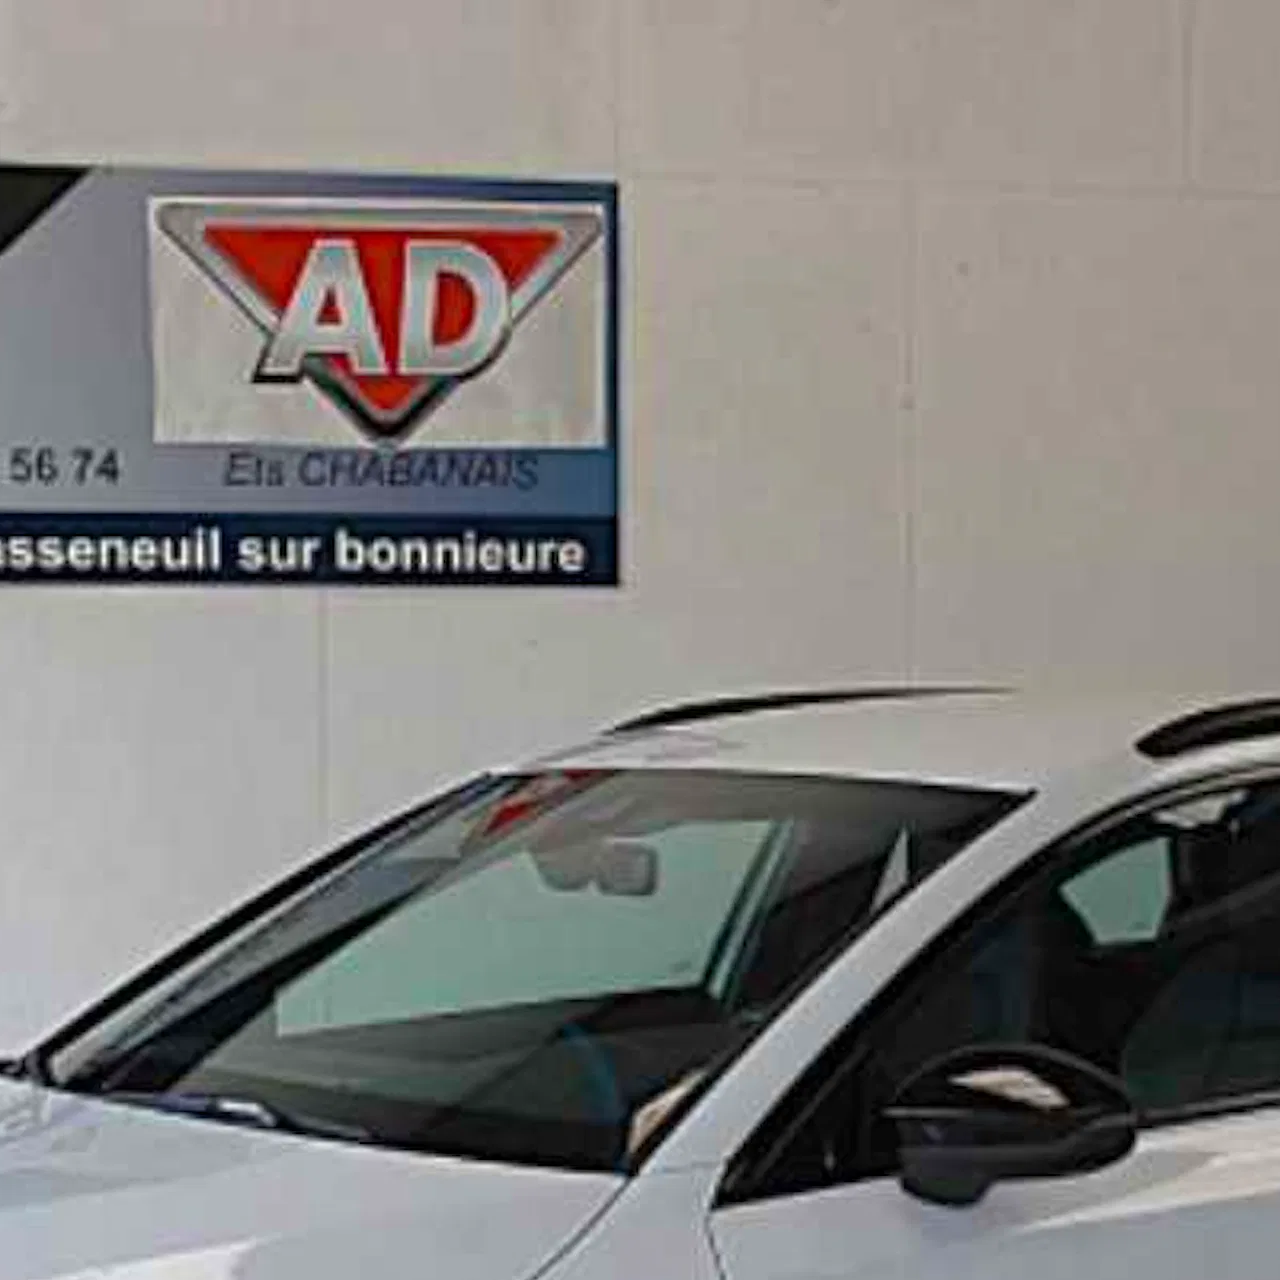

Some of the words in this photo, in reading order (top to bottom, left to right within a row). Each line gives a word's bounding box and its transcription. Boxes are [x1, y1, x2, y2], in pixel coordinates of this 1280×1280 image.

[253, 238, 512, 382] AD
[9, 449, 58, 484] 56
[72, 449, 121, 485] 74
[297, 451, 539, 489] CHABANAIS
[237, 537, 320, 572] sur
[335, 527, 587, 575] bonnieure
